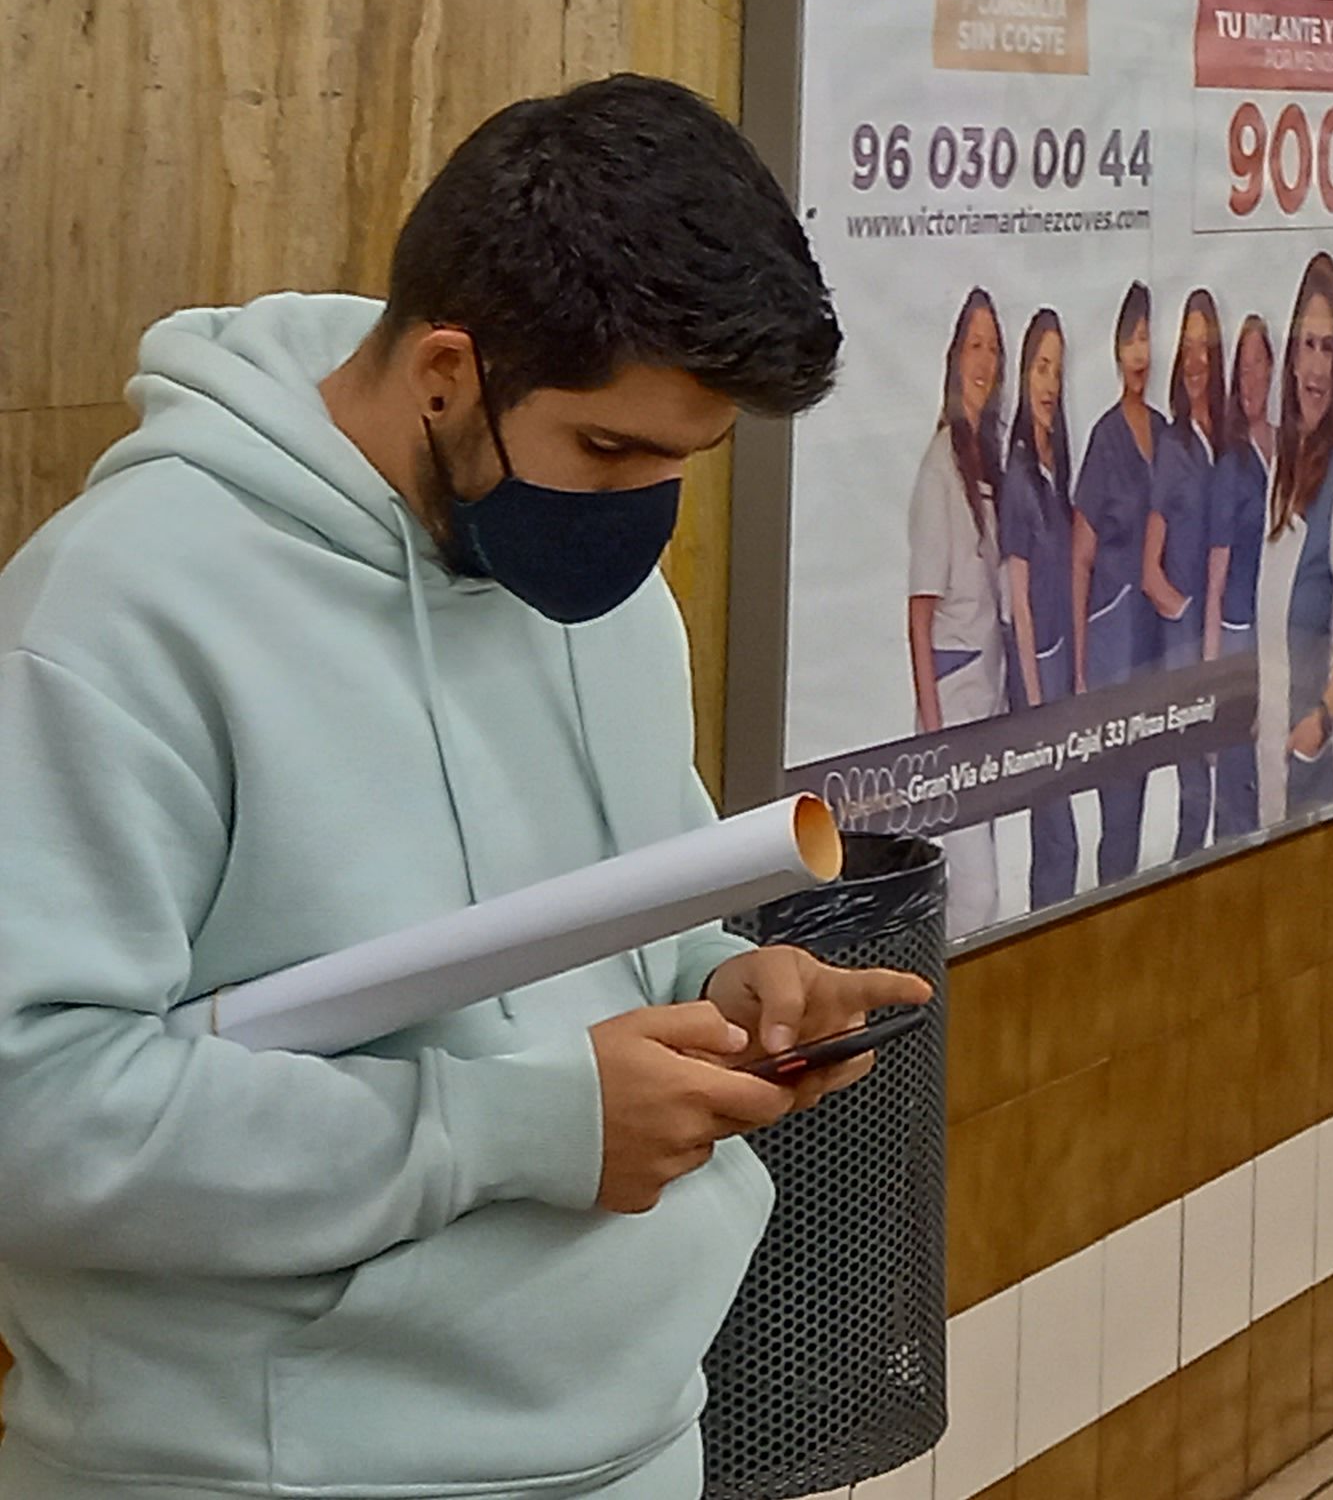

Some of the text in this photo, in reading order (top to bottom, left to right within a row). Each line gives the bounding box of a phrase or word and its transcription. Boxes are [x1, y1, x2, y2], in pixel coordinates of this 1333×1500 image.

[1001, 22, 1067, 56] COSTE
[1214, 9, 1243, 40] TU
[1245, 11, 1323, 45] IMPLANTE
[850, 123, 1153, 191] 96 030 00 44
[846, 204, 1150, 238] www.victoriamartinezcoves.com
[979, 753, 1000, 784] de
[1054, 743, 1067, 772] y
[1104, 719, 1127, 748] 33
